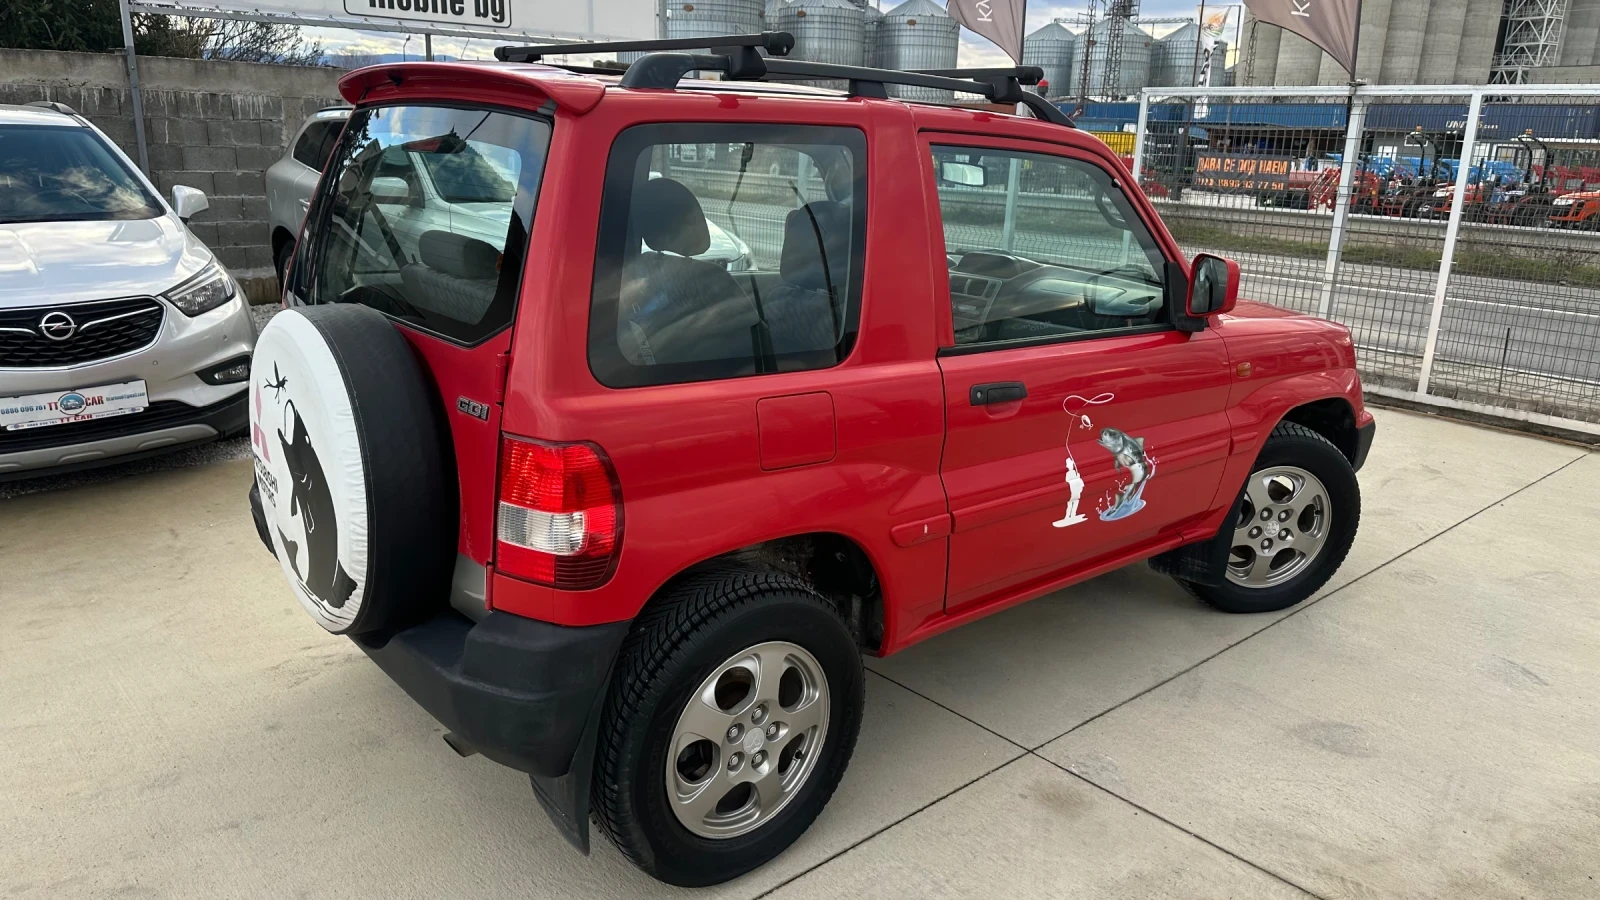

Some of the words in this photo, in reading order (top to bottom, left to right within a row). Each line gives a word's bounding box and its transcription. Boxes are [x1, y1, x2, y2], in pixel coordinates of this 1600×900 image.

[47, 401, 59, 411] TT
[84, 395, 104, 407] CAR
[457, 396, 489, 421] GDI
